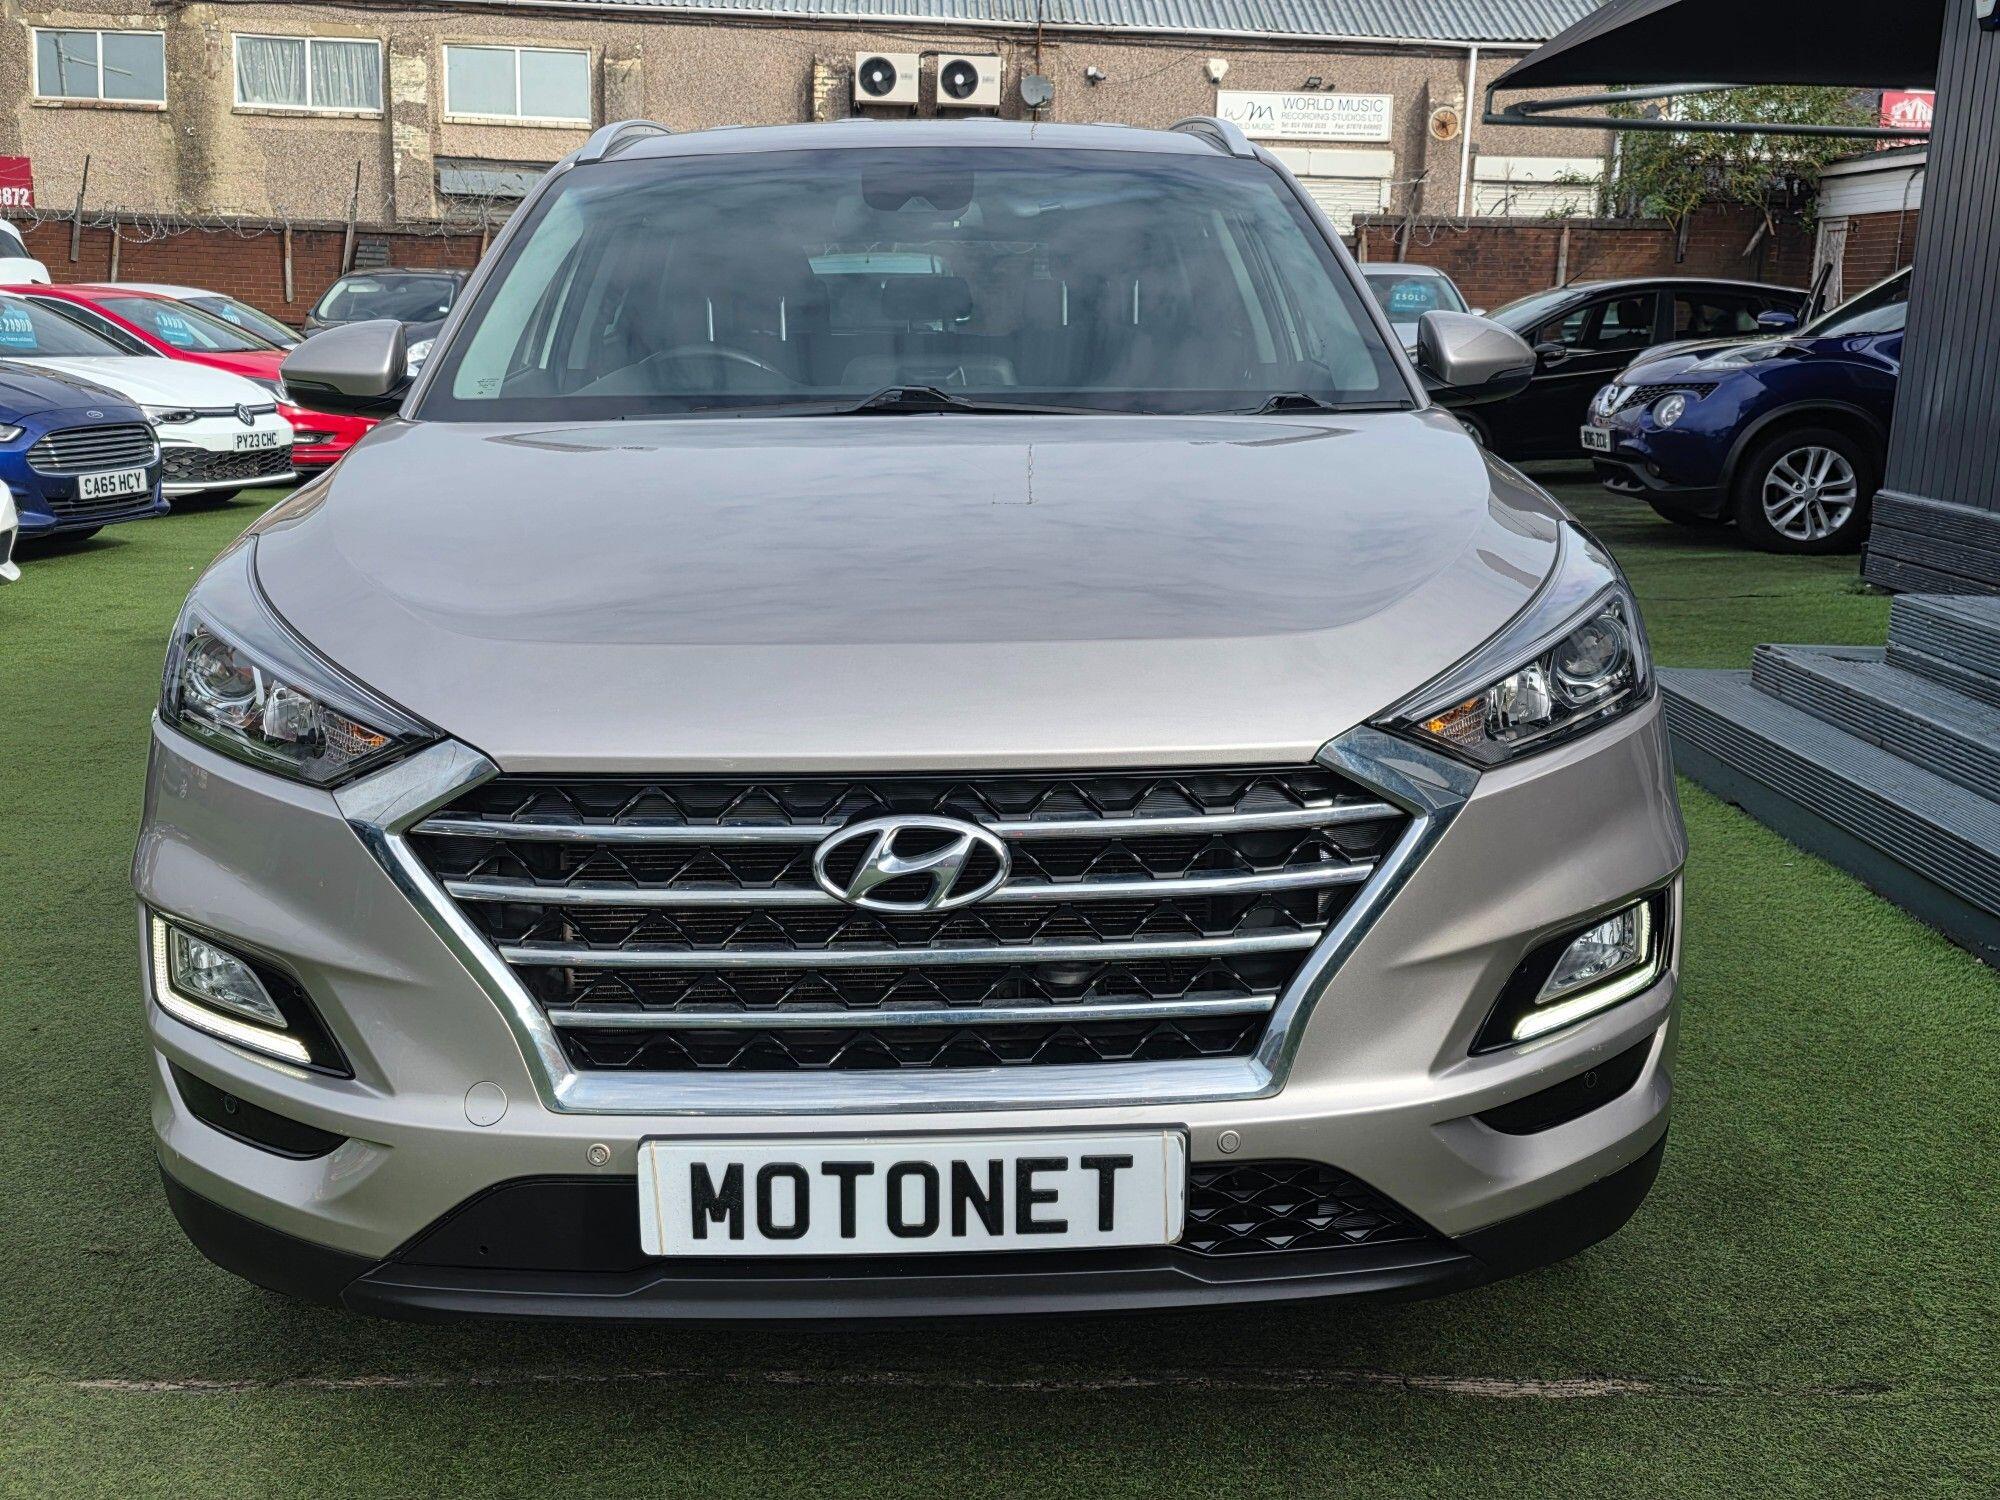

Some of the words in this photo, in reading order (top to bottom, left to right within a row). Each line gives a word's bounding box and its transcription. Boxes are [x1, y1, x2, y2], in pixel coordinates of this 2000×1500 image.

[1282, 97, 1334, 110] WORLD
[1339, 99, 1383, 112] MUSIC
[1281, 111, 1329, 121] RECORDING
[1332, 113, 1366, 122] STUDIOS
[1368, 114, 1383, 122] LTD
[0, 187, 30, 206] 872
[236, 433, 260, 449] PY23
[261, 432, 277, 447] CHC
[84, 475, 116, 495] CA65
[118, 472, 141, 491] HCY
[689, 1153, 1134, 1241] MOTONET
